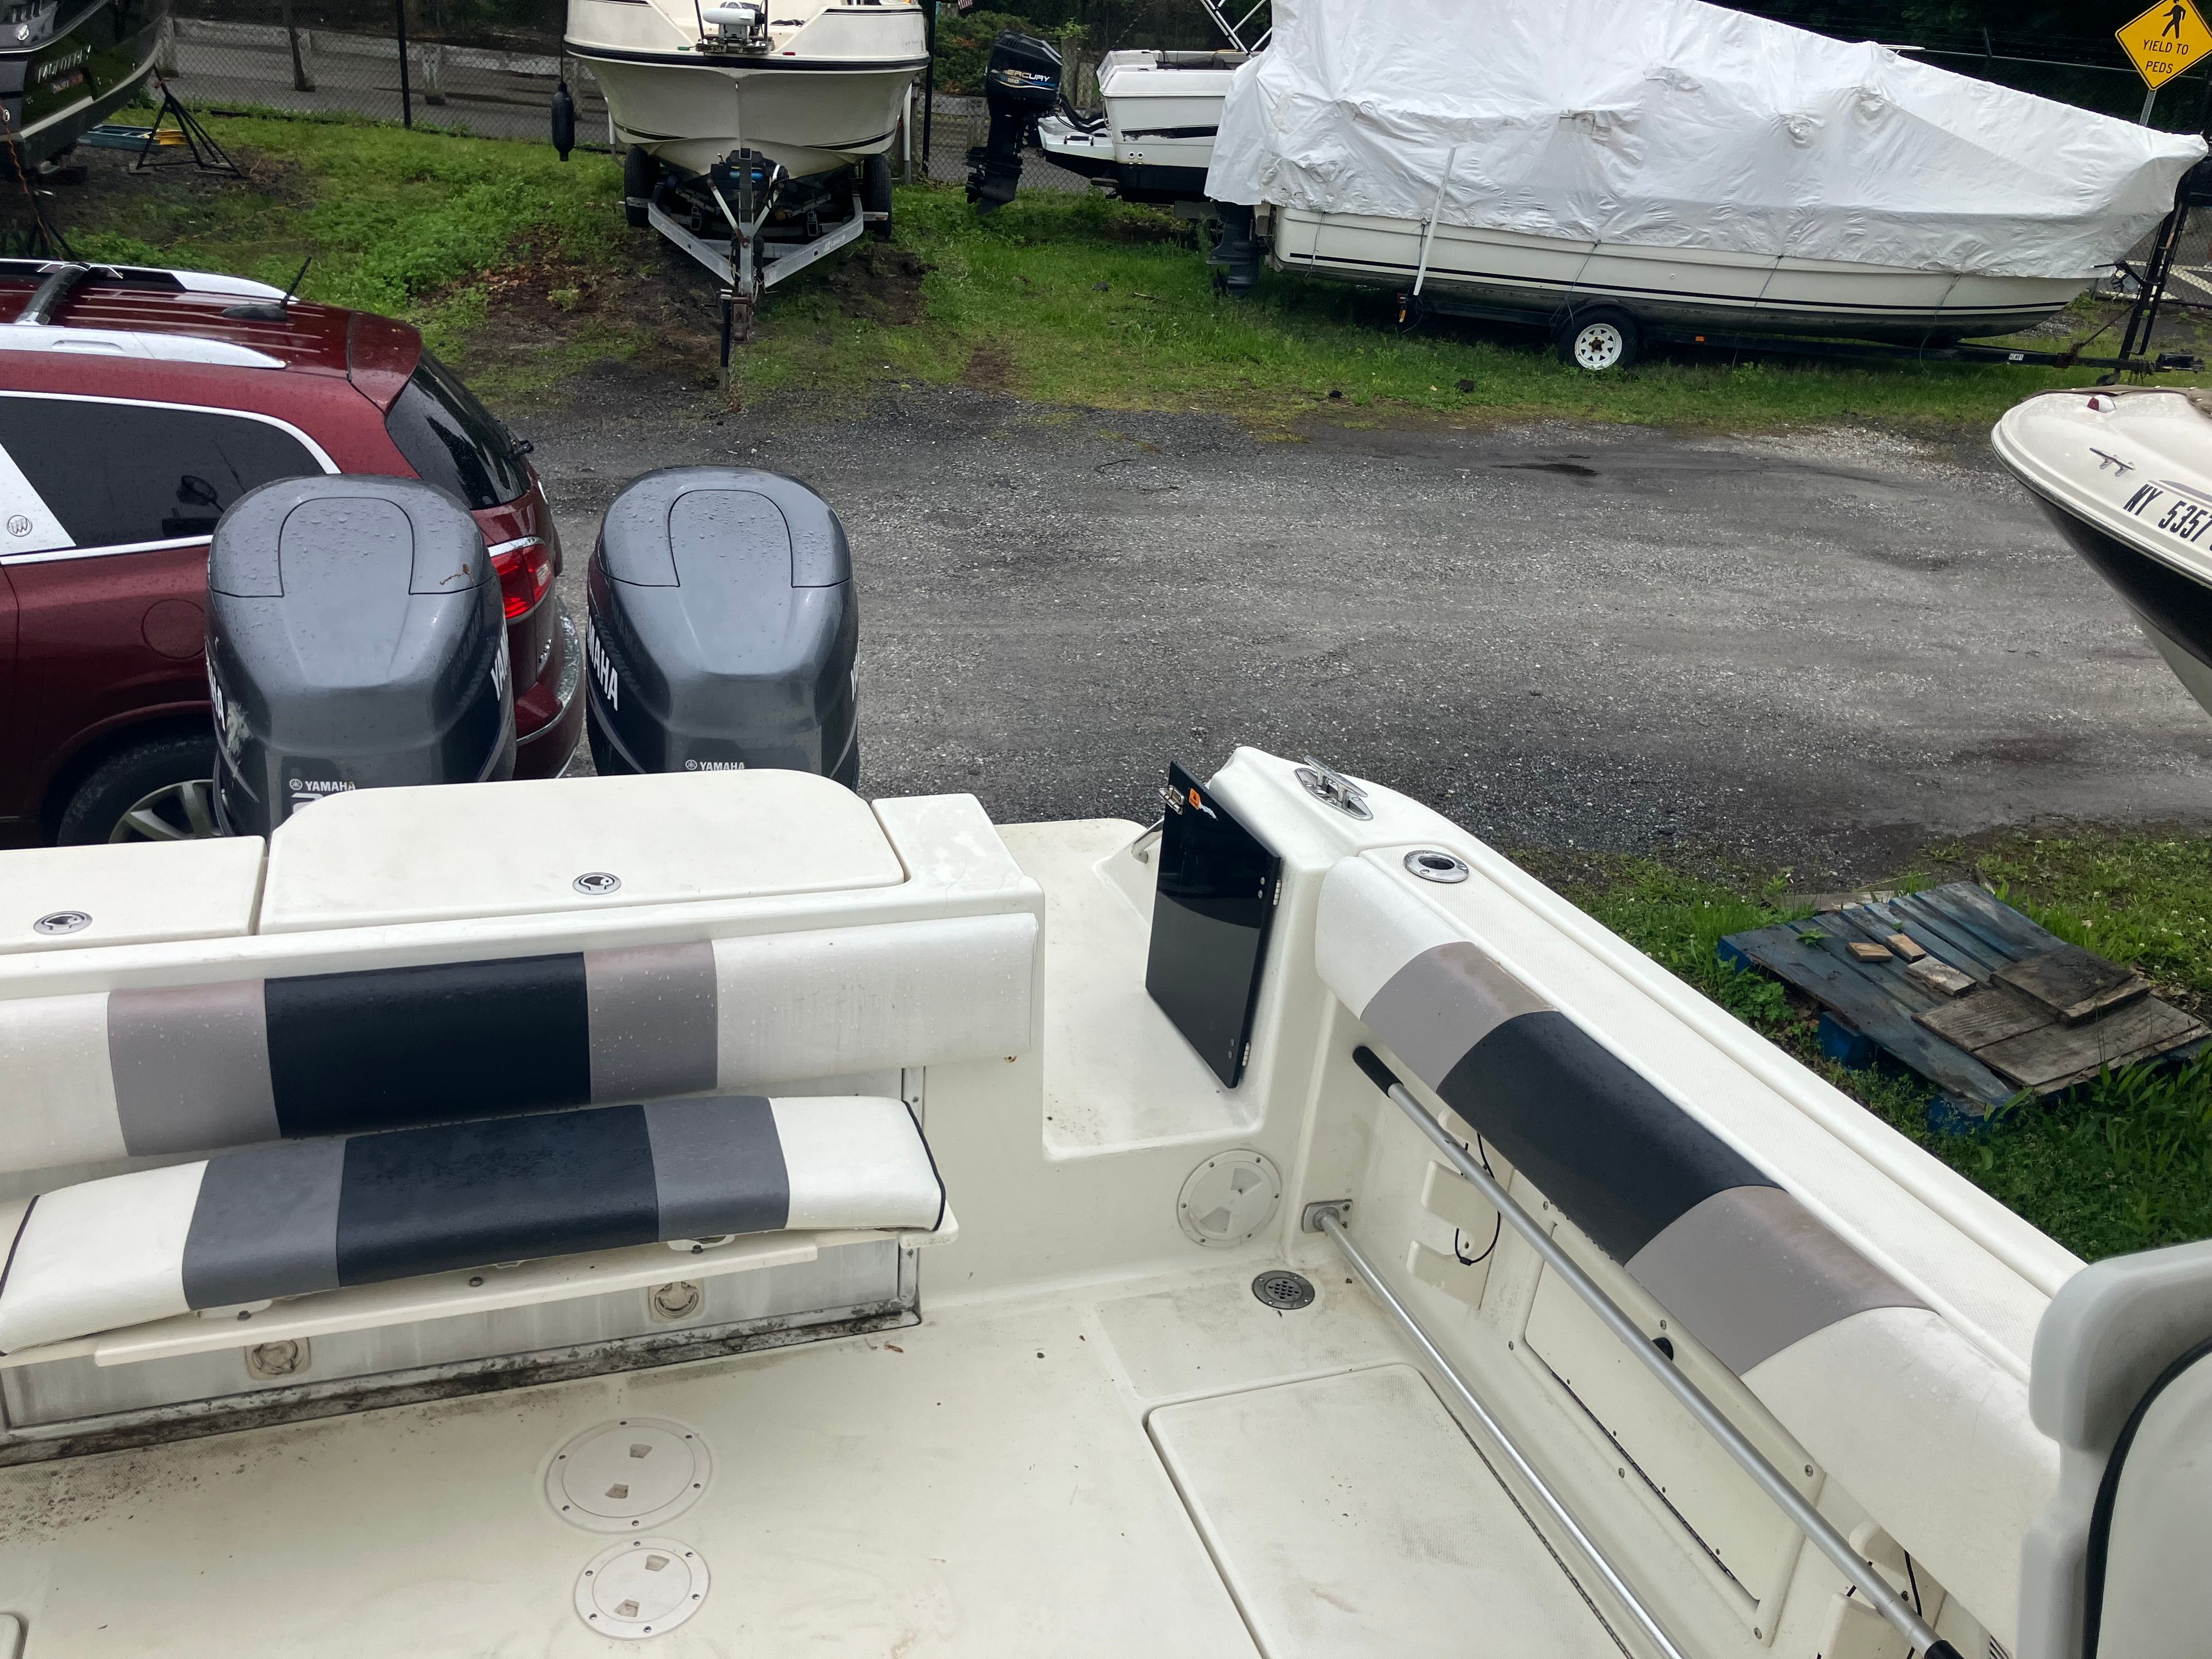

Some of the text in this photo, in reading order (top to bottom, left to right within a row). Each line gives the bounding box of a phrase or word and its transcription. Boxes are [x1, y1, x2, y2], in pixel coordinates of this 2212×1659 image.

[2143, 39, 2189, 55] YIELD TO
[2145, 61, 2174, 74] PEDS
[2123, 483, 2212, 543] NY 5357
[588, 613, 618, 712] MAHA
[700, 761, 744, 771] YAMAHA
[304, 781, 356, 791] YAMAHA
